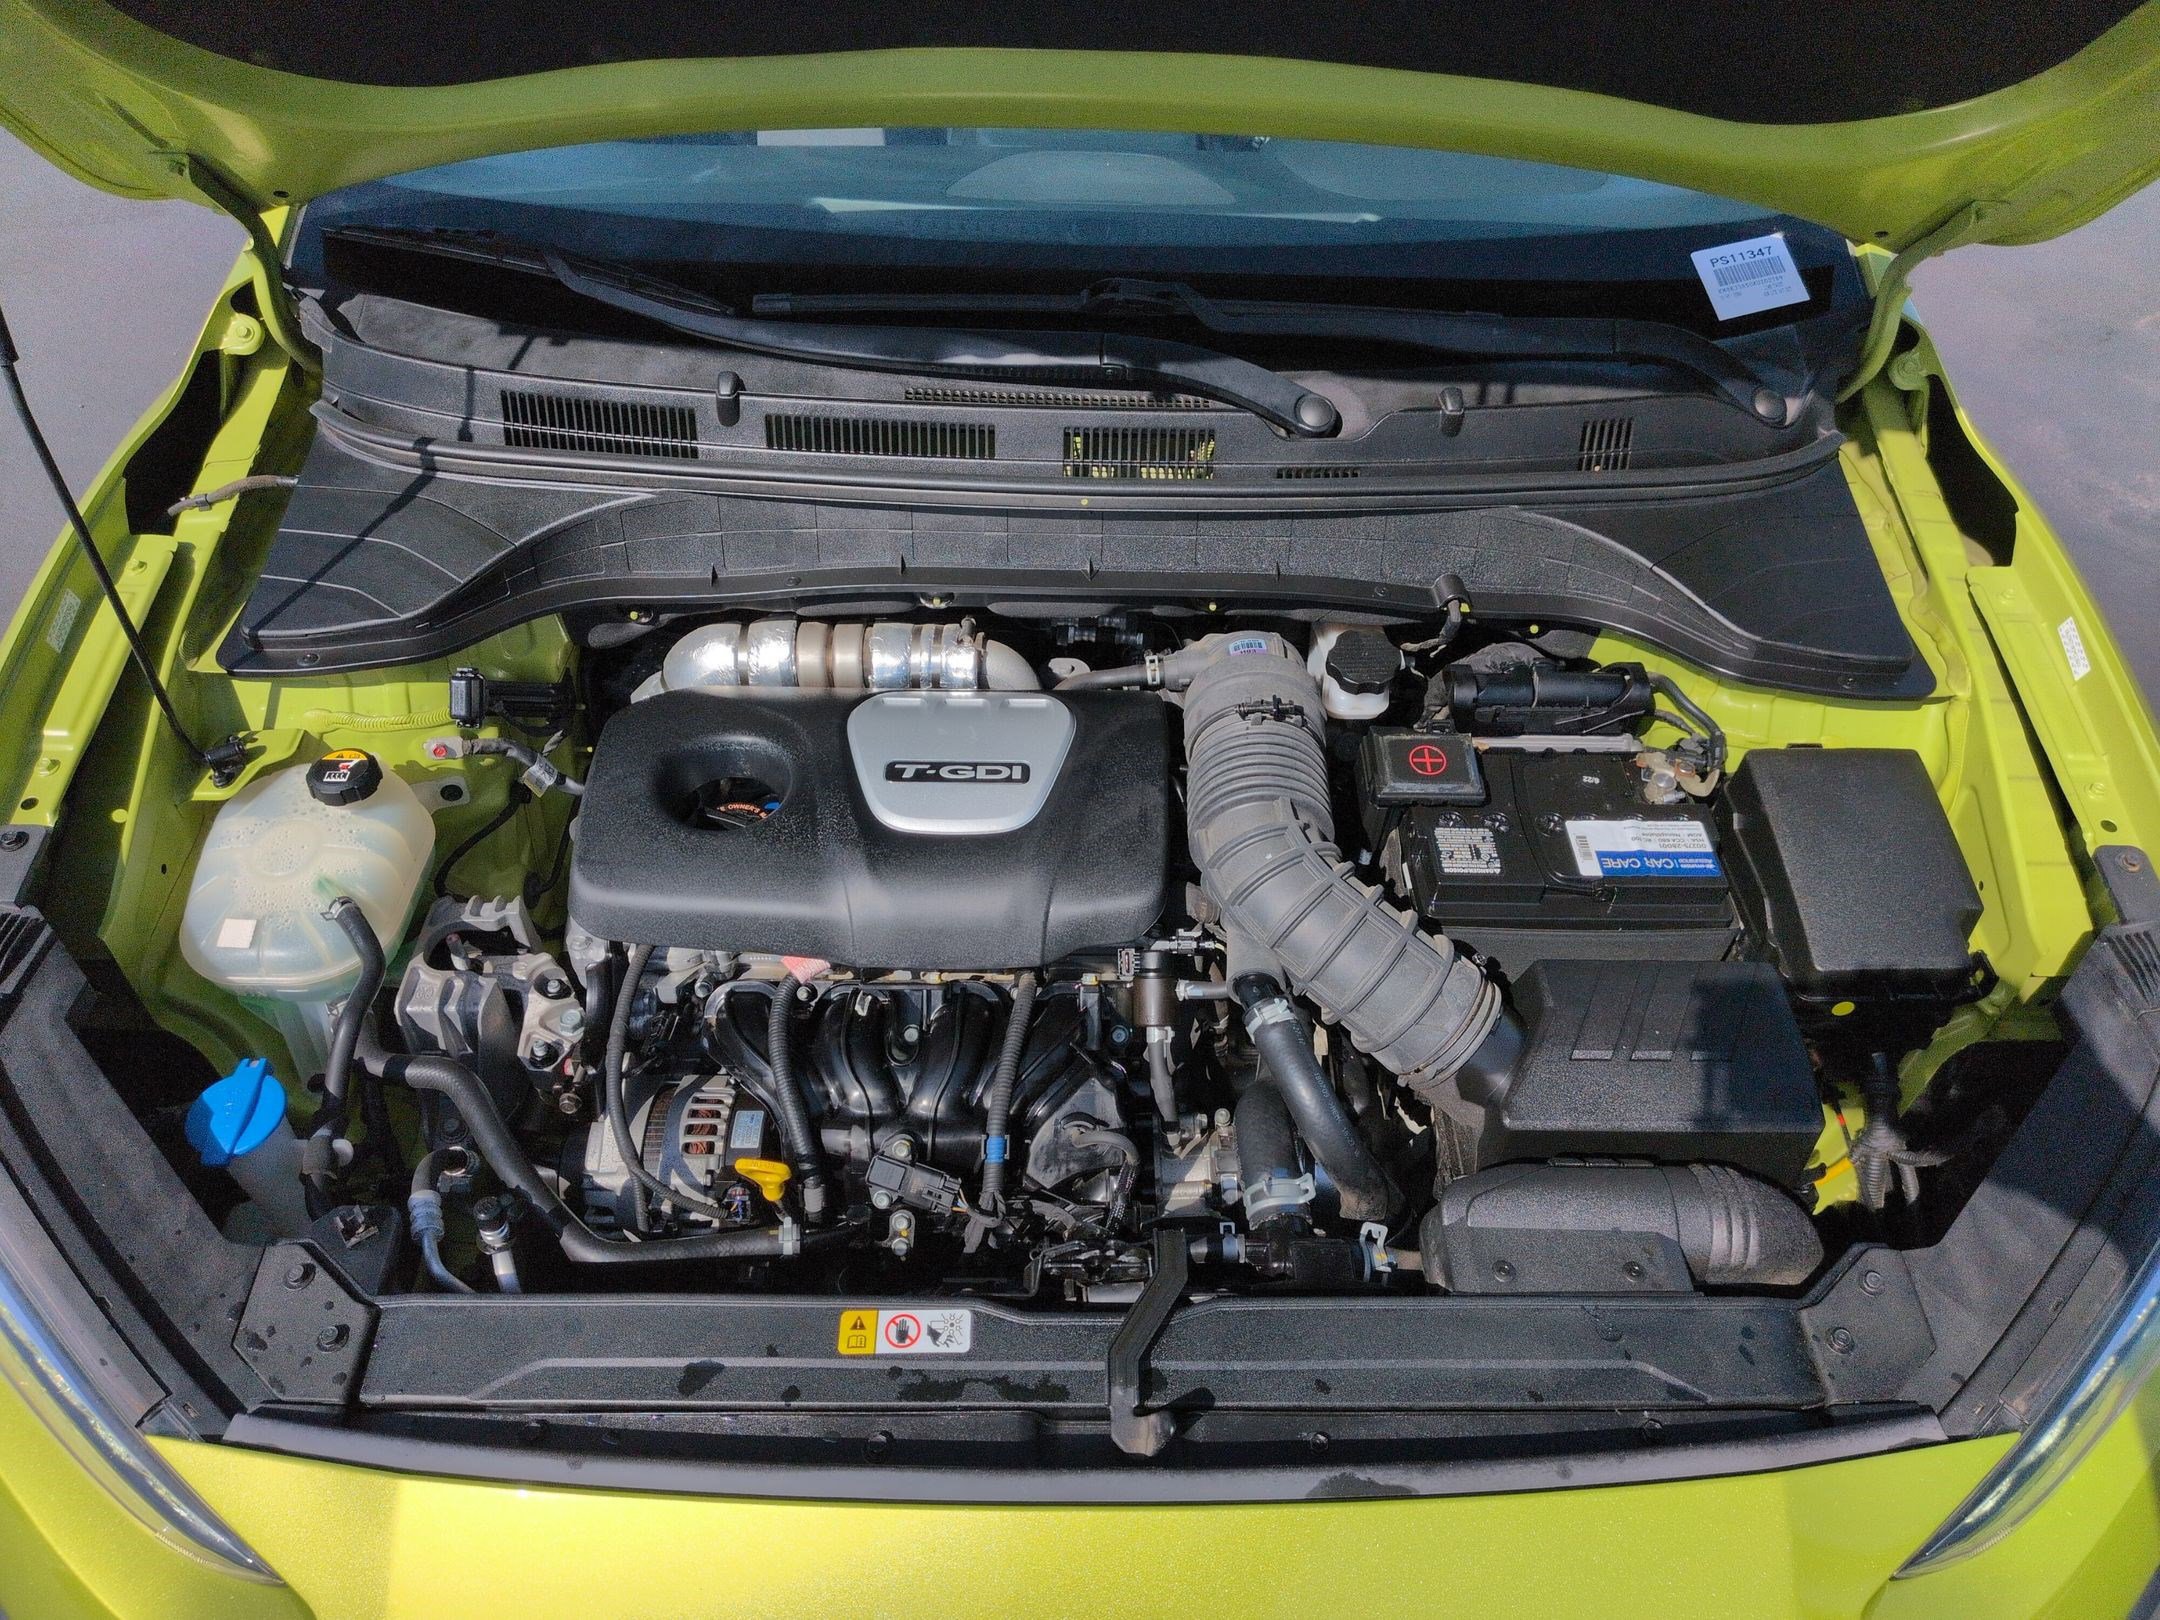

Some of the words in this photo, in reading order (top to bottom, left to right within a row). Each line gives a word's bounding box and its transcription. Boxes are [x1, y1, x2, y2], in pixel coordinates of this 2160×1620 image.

[1709, 245, 1773, 268] PS11347
[894, 764, 1022, 779] T-GDI
[1602, 858, 1640, 868] CARE
[1644, 857, 1674, 868] CAR
